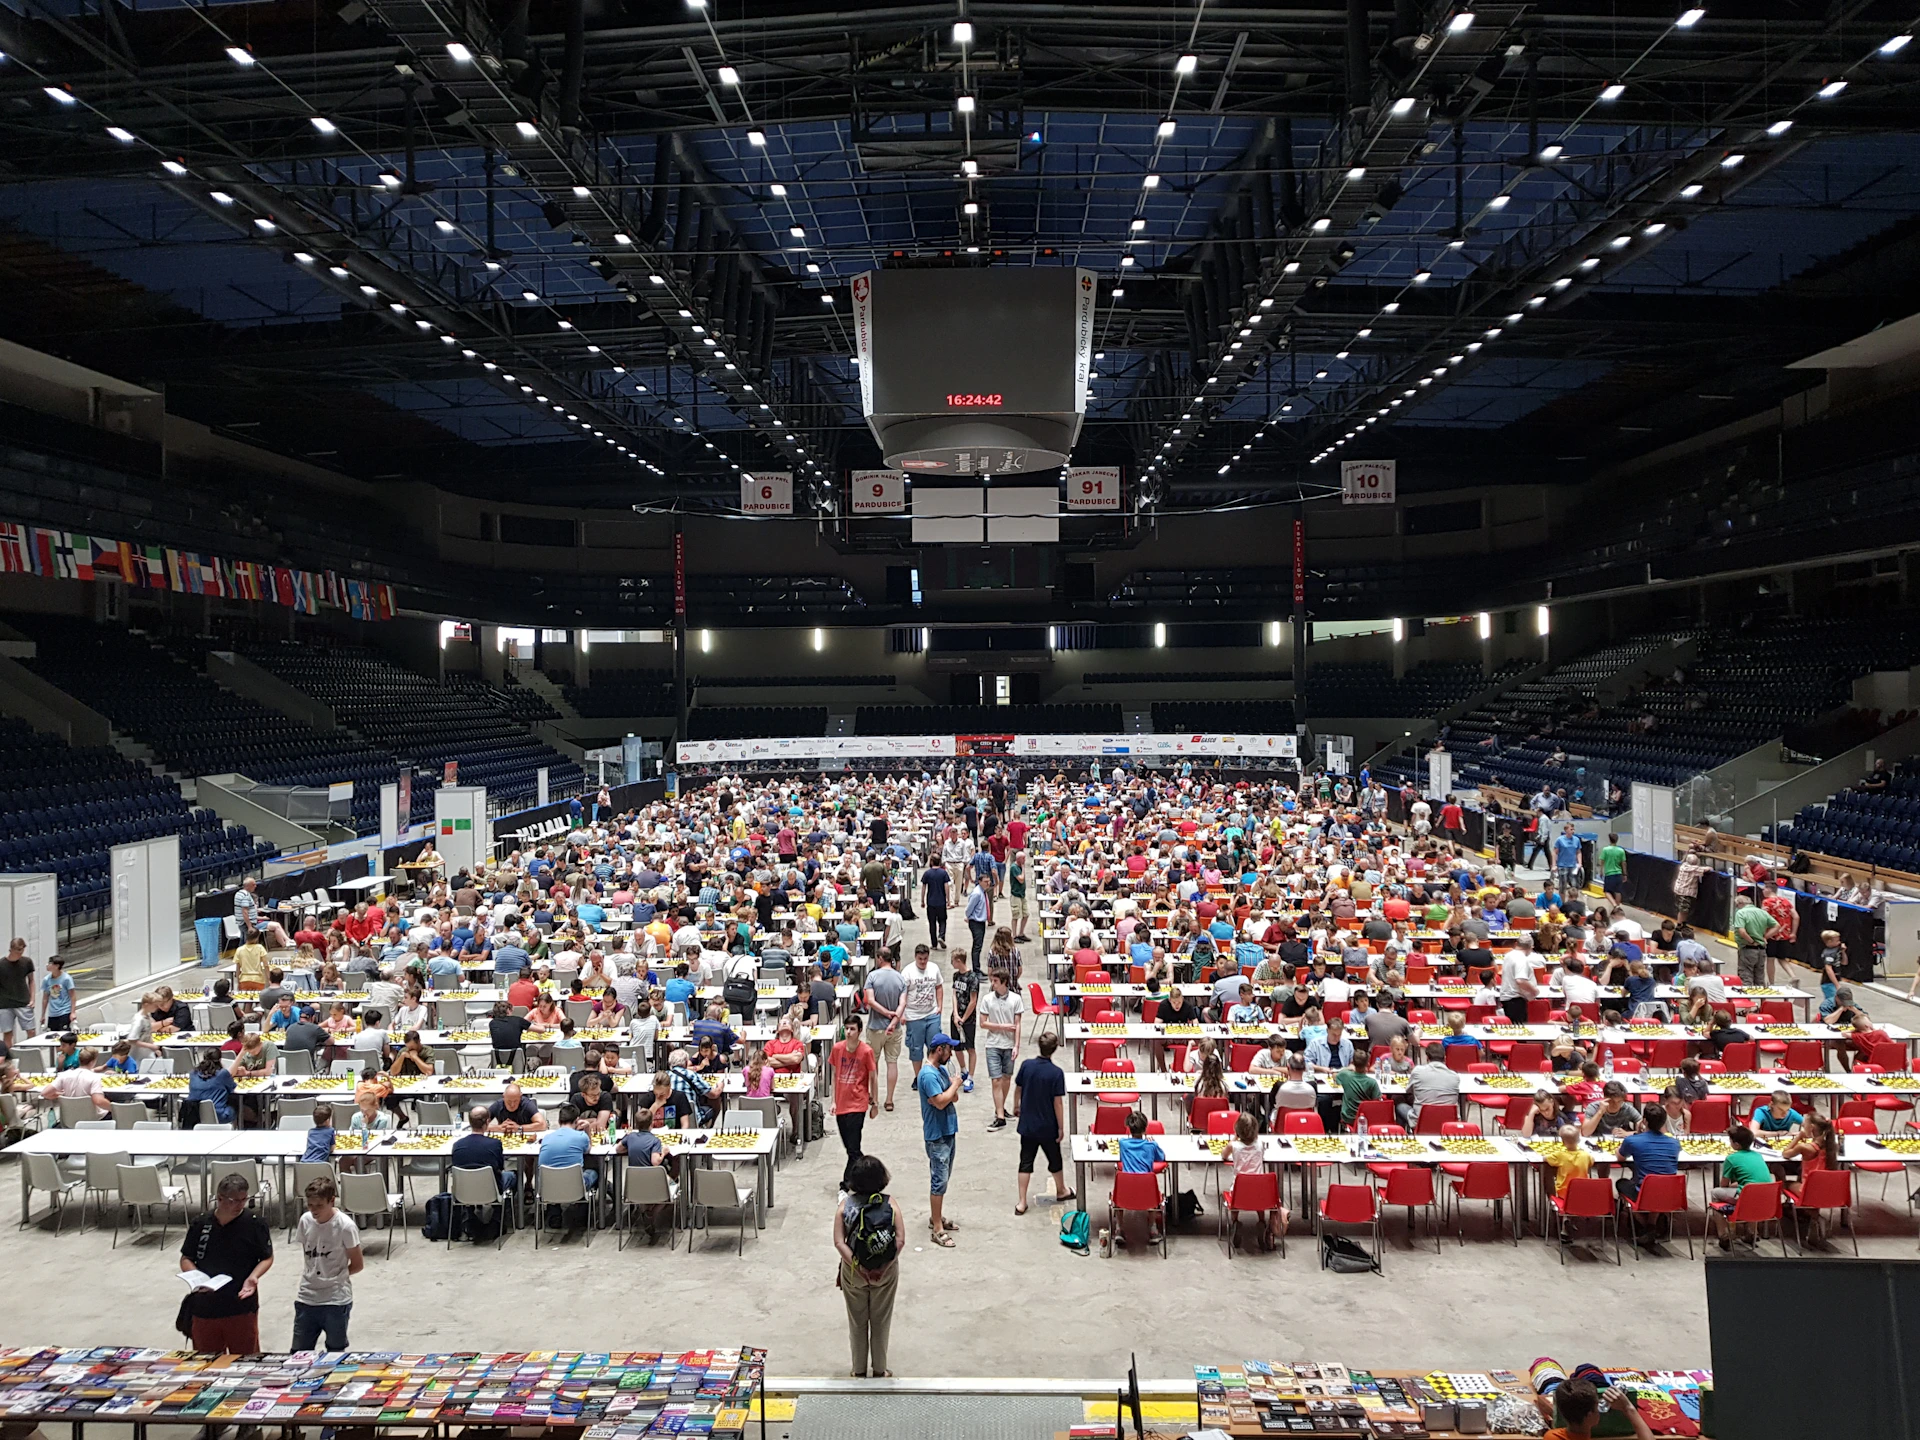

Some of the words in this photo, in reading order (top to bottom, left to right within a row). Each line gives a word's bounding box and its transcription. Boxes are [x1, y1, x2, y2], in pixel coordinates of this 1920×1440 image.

[859, 305, 867, 353] Pardubice
[1078, 296, 1090, 359] Pardubický
[1077, 363, 1087, 383] kraj
[946, 394, 1002, 406] 16:24:42
[855, 474, 879, 482] DOMINIK
[1068, 470, 1090, 479] OTAKAR
[1357, 474, 1379, 488] 10
[761, 486, 773, 499] 6
[871, 484, 884, 497] 9
[1082, 480, 1103, 494] 91
[854, 501, 902, 509] PARDUBICE
